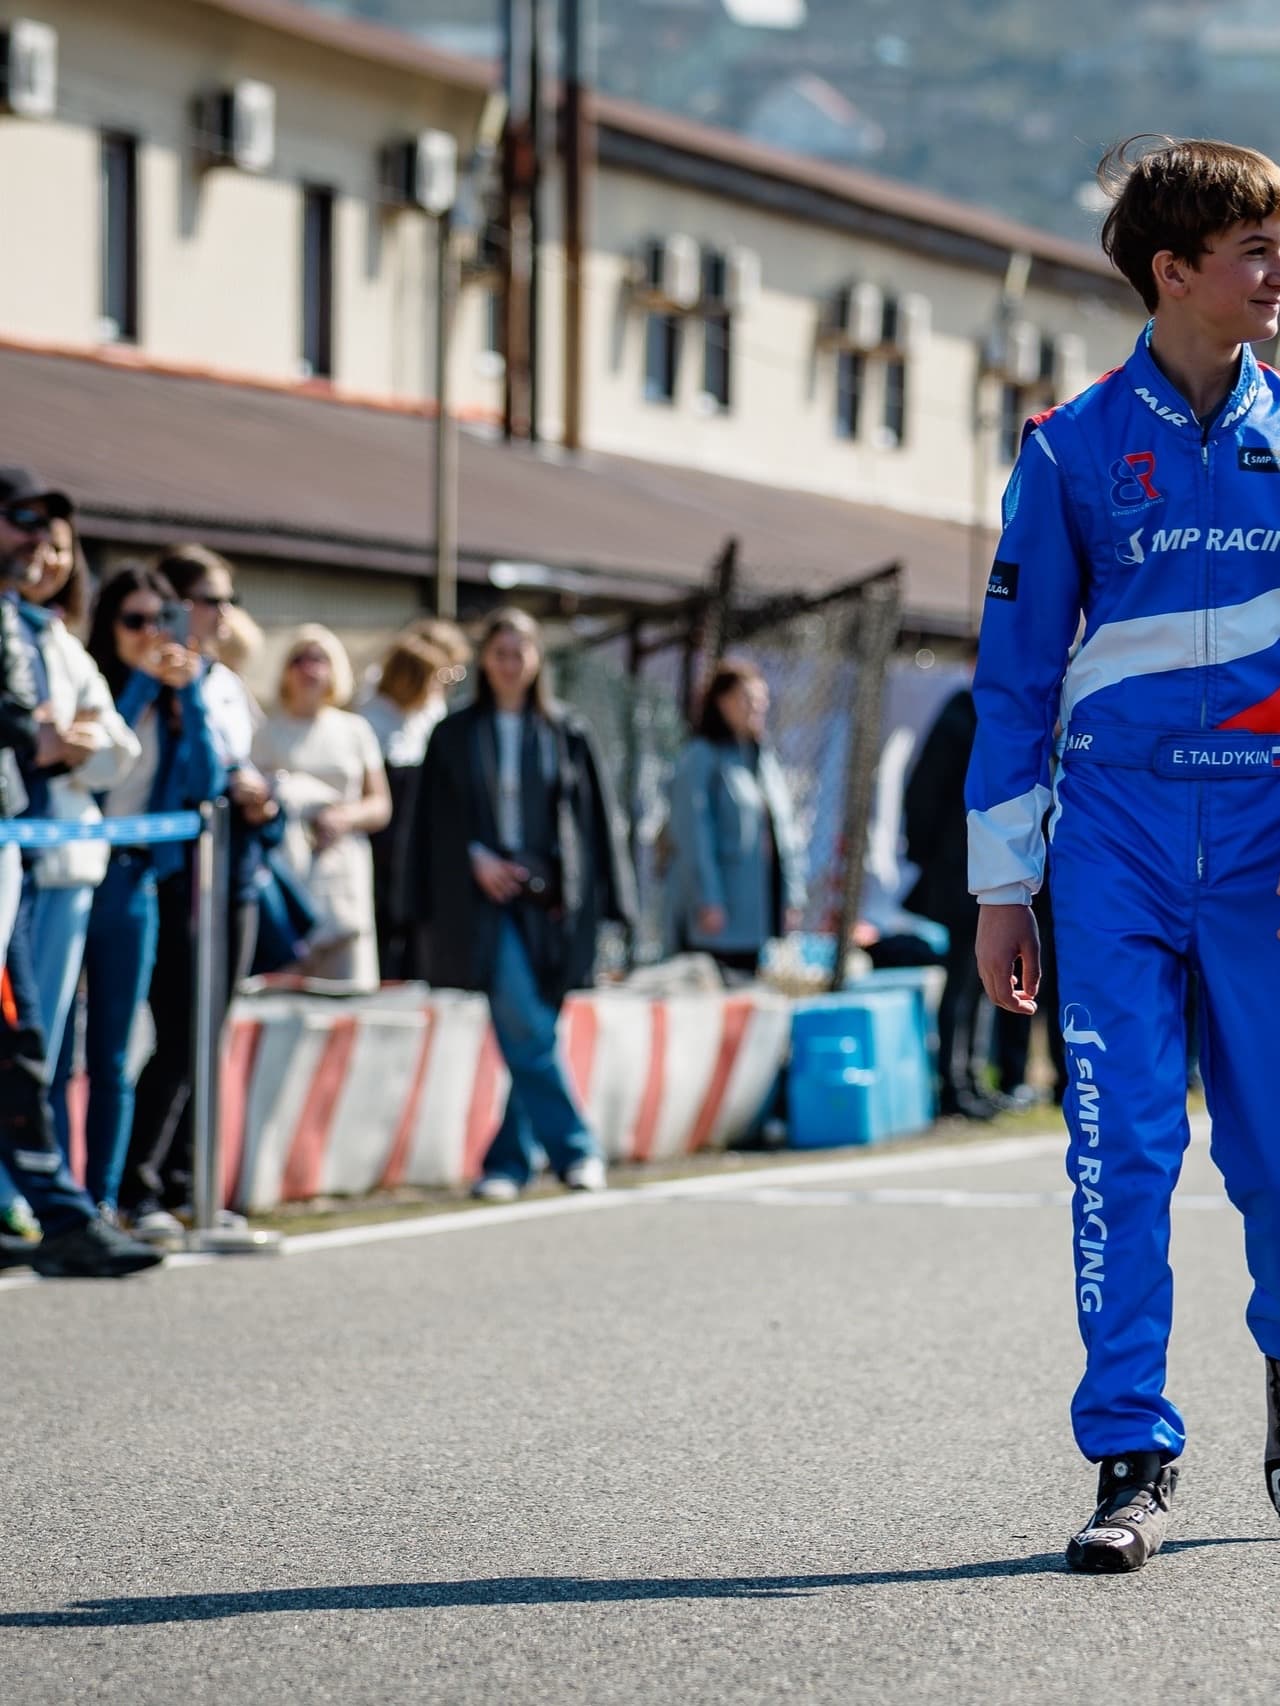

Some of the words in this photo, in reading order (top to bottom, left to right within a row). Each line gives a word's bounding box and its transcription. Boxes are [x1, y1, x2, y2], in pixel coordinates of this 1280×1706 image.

[1251, 456, 1272, 464] SMP
[1173, 750, 1270, 765] E.TALDYKIN
[1075, 1057, 1100, 1149] SMP
[1078, 1155, 1108, 1314] RACING
